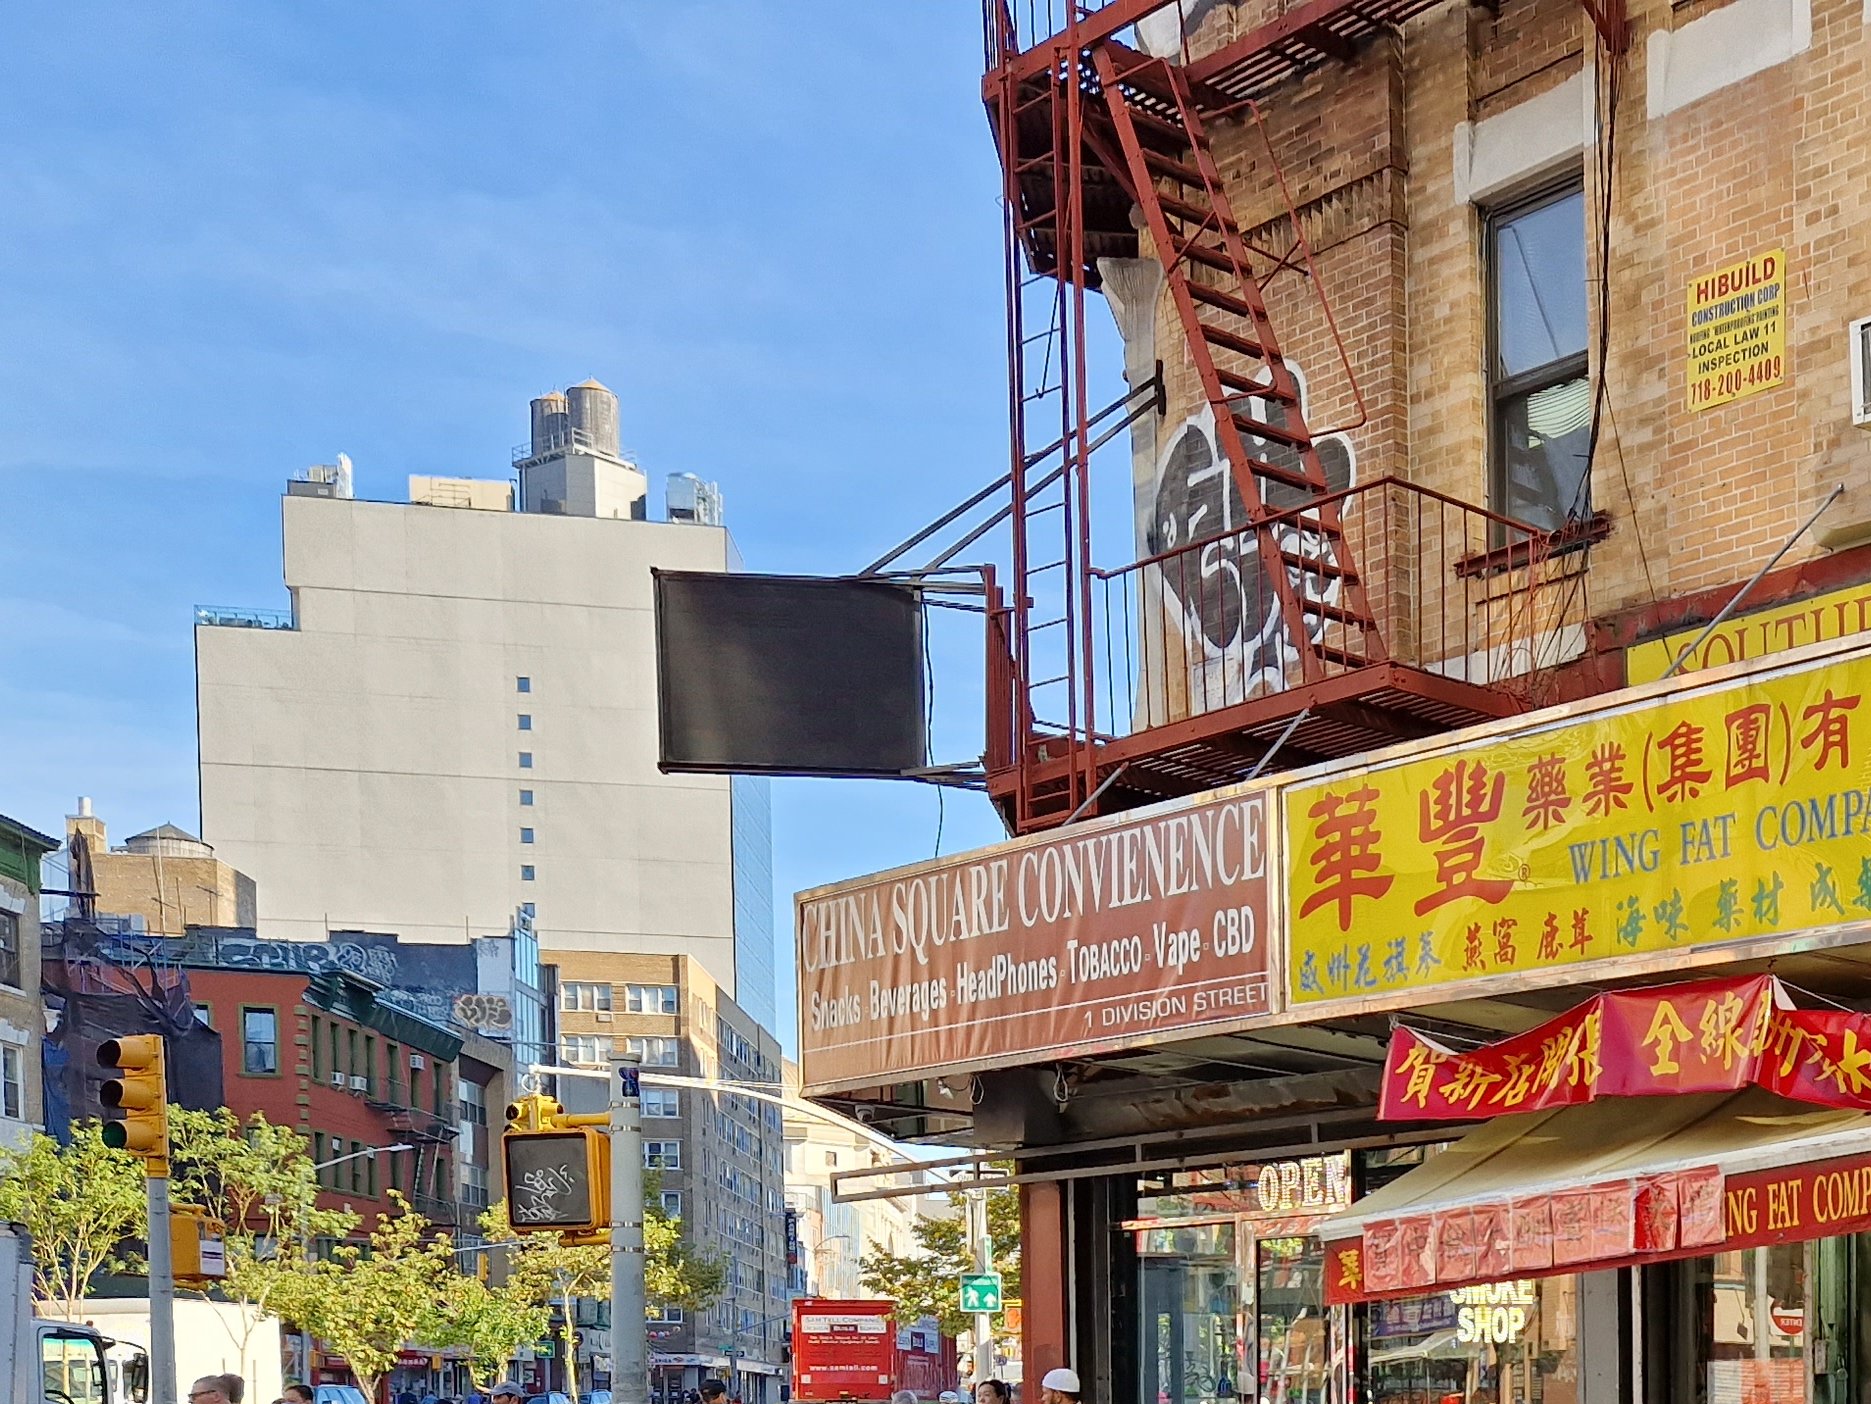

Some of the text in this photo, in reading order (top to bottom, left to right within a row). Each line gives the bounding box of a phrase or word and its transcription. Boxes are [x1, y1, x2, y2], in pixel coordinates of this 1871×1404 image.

[1691, 283, 1781, 328] CONSTRUCTION CORP
[1696, 257, 1776, 304] HIBUILD
[1692, 321, 1777, 359] LOCAL LAW 11
[1698, 341, 1769, 374] INSPECTION
[1691, 355, 1781, 405] 718-200-4409
[1299, 759, 1516, 932] 華豐
[1569, 829, 1661, 885] WING
[1680, 812, 1736, 867] FAT
[802, 798, 1266, 974] CHINA SQUARE CONVIENENCE
[1615, 887, 1689, 948] 海味
[811, 986, 862, 1032] Snacks
[868, 975, 947, 1023] Beverages
[957, 953, 1058, 1005] HeadPhones
[1153, 921, 1200, 975] Vape
[1212, 905, 1255, 958] CBD
[1085, 981, 1268, 1028] 1 DIVISION STREET
[1258, 1156, 1348, 1211] OPEN
[1724, 1187, 1757, 1238] ING
[1767, 1179, 1802, 1230] FAT
[1456, 1306, 1525, 1343] SHOP
